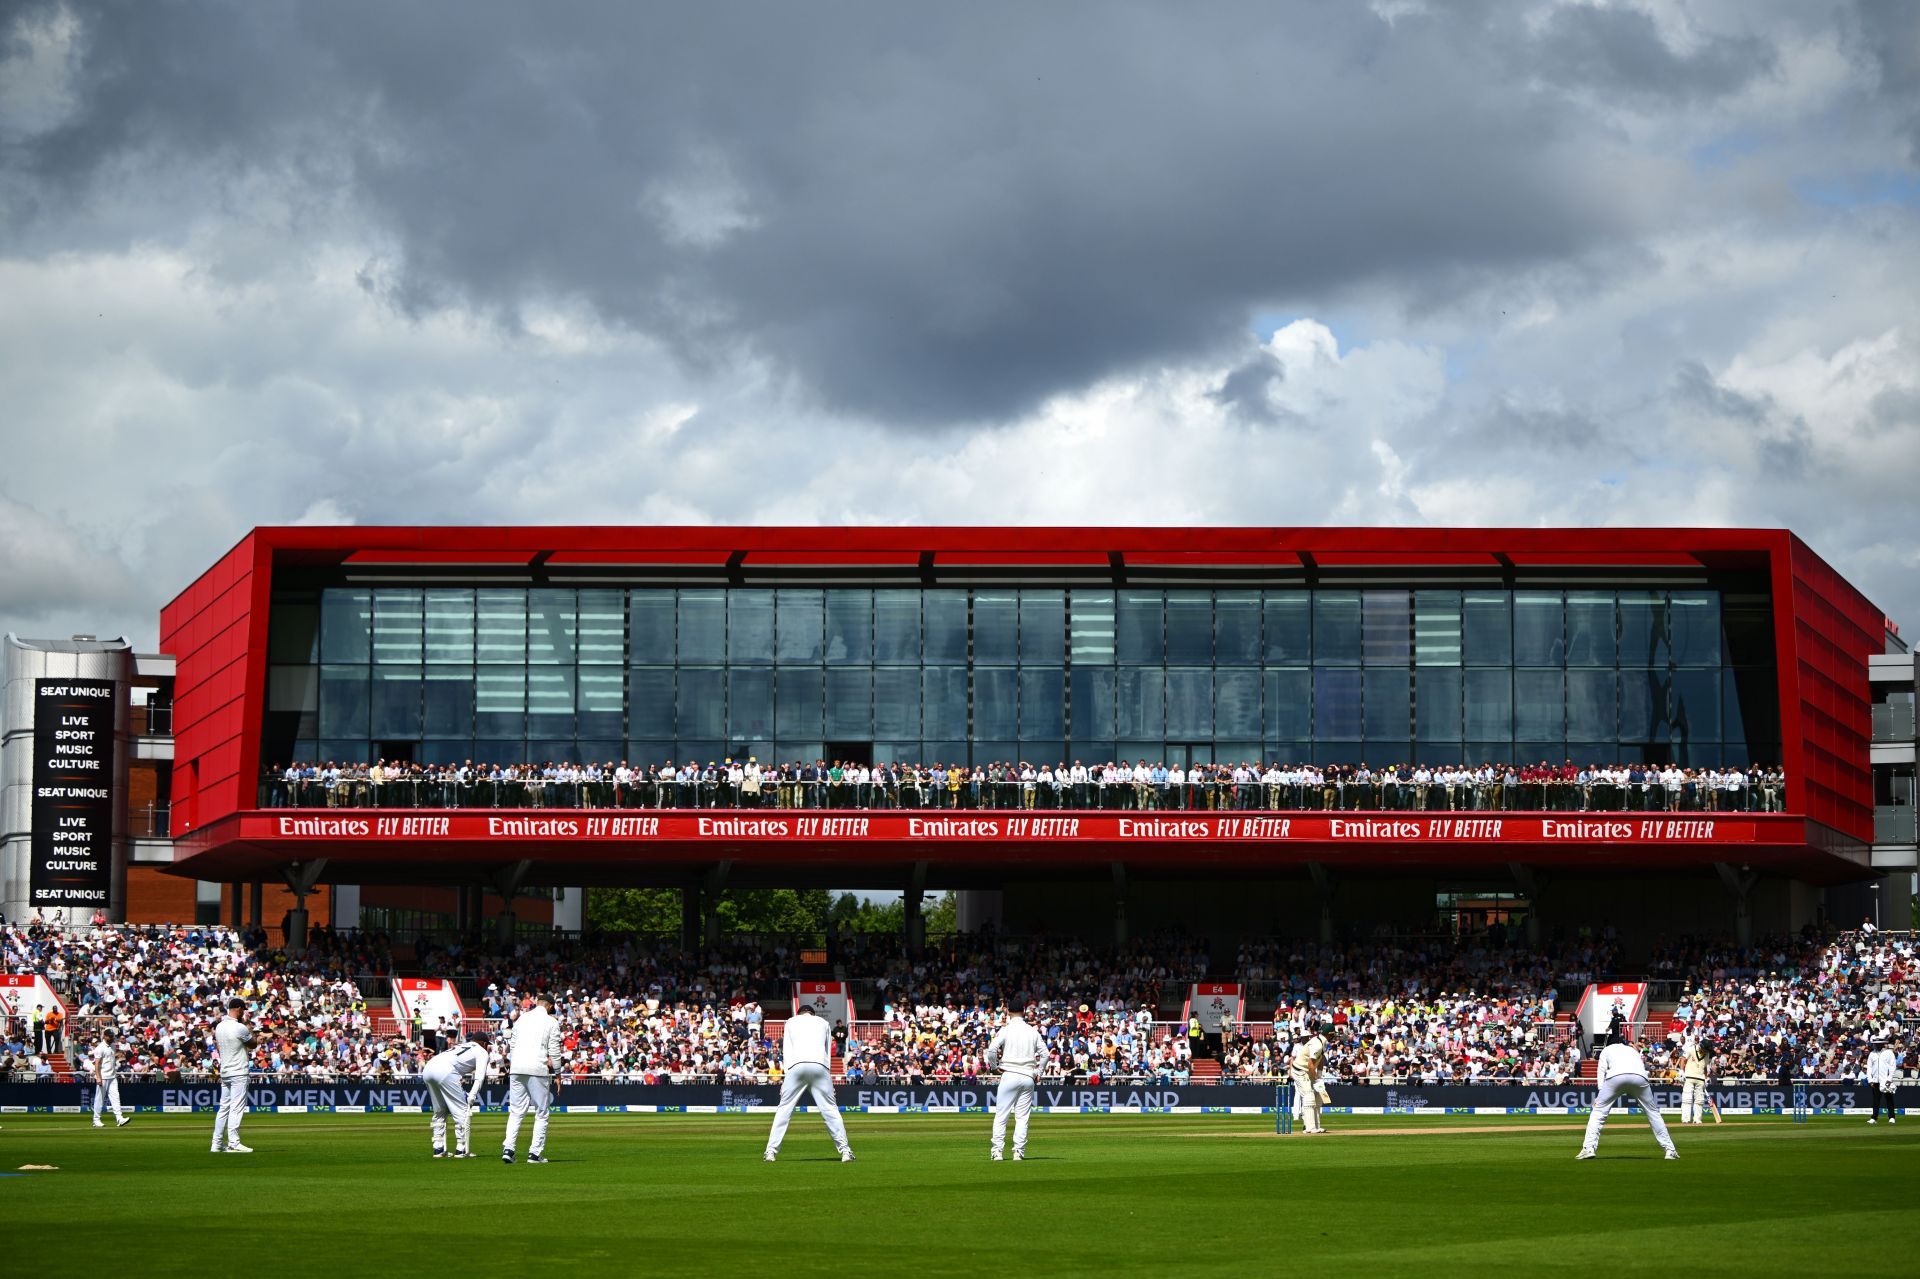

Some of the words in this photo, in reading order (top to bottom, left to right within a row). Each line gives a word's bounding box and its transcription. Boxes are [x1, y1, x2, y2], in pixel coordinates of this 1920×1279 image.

[41, 687, 68, 696] SEAT
[70, 687, 110, 698] UNIQUE
[62, 716, 89, 726] LIVE
[55, 730, 95, 740] SPORT
[56, 745, 93, 755] MUSIC
[48, 759, 100, 769] CULTURE
[38, 787, 66, 797] SEAT
[67, 788, 108, 798] UNIQUE
[59, 818, 86, 827] LIVE
[280, 817, 369, 835] Emirates
[377, 817, 400, 836] FLY
[402, 818, 449, 836] BETTER
[488, 817, 578, 835] Emirates
[586, 817, 609, 836] FLY
[611, 818, 658, 836] BETTER
[698, 817, 788, 836] Emirates
[796, 817, 819, 836] FLY
[821, 818, 869, 836] BETTER
[909, 818, 998, 836] Emirates
[1006, 818, 1029, 837] FLY
[1031, 819, 1079, 837] BETTER
[1118, 818, 1208, 837] Emirates
[1216, 818, 1240, 837] FLY
[1242, 819, 1290, 837] BETTER
[1330, 819, 1420, 838] Emirates
[1428, 819, 1451, 838] FLY
[1453, 820, 1501, 838] BETTER
[1542, 819, 1632, 838] Emirates
[1640, 820, 1663, 839] FLY
[1665, 821, 1714, 839] BETTER
[53, 832, 92, 841] SPORT
[53, 846, 91, 856] MUSIC
[46, 861, 97, 870] CULTURE
[36, 889, 63, 899] SEAT
[64, 890, 106, 900] UNIQUE
[9, 977, 19, 985] E1
[416, 981, 428, 989] E2
[815, 984, 826, 992] E3
[1612, 985, 1624, 993] E5
[163, 1089, 276, 1106] ENGLND
[285, 1089, 335, 1106] MEN
[344, 1090, 361, 1106] V
[370, 1090, 427, 1106] NEW
[858, 1090, 977, 1107] ENGLAND
[986, 1090, 1038, 1107] MN
[1046, 1091, 1063, 1107] V
[1072, 1091, 1180, 1107] IRELAND
[1525, 1091, 1786, 1108] AUGUT-EPEMBER
[1793, 1091, 1856, 1108] 2023
